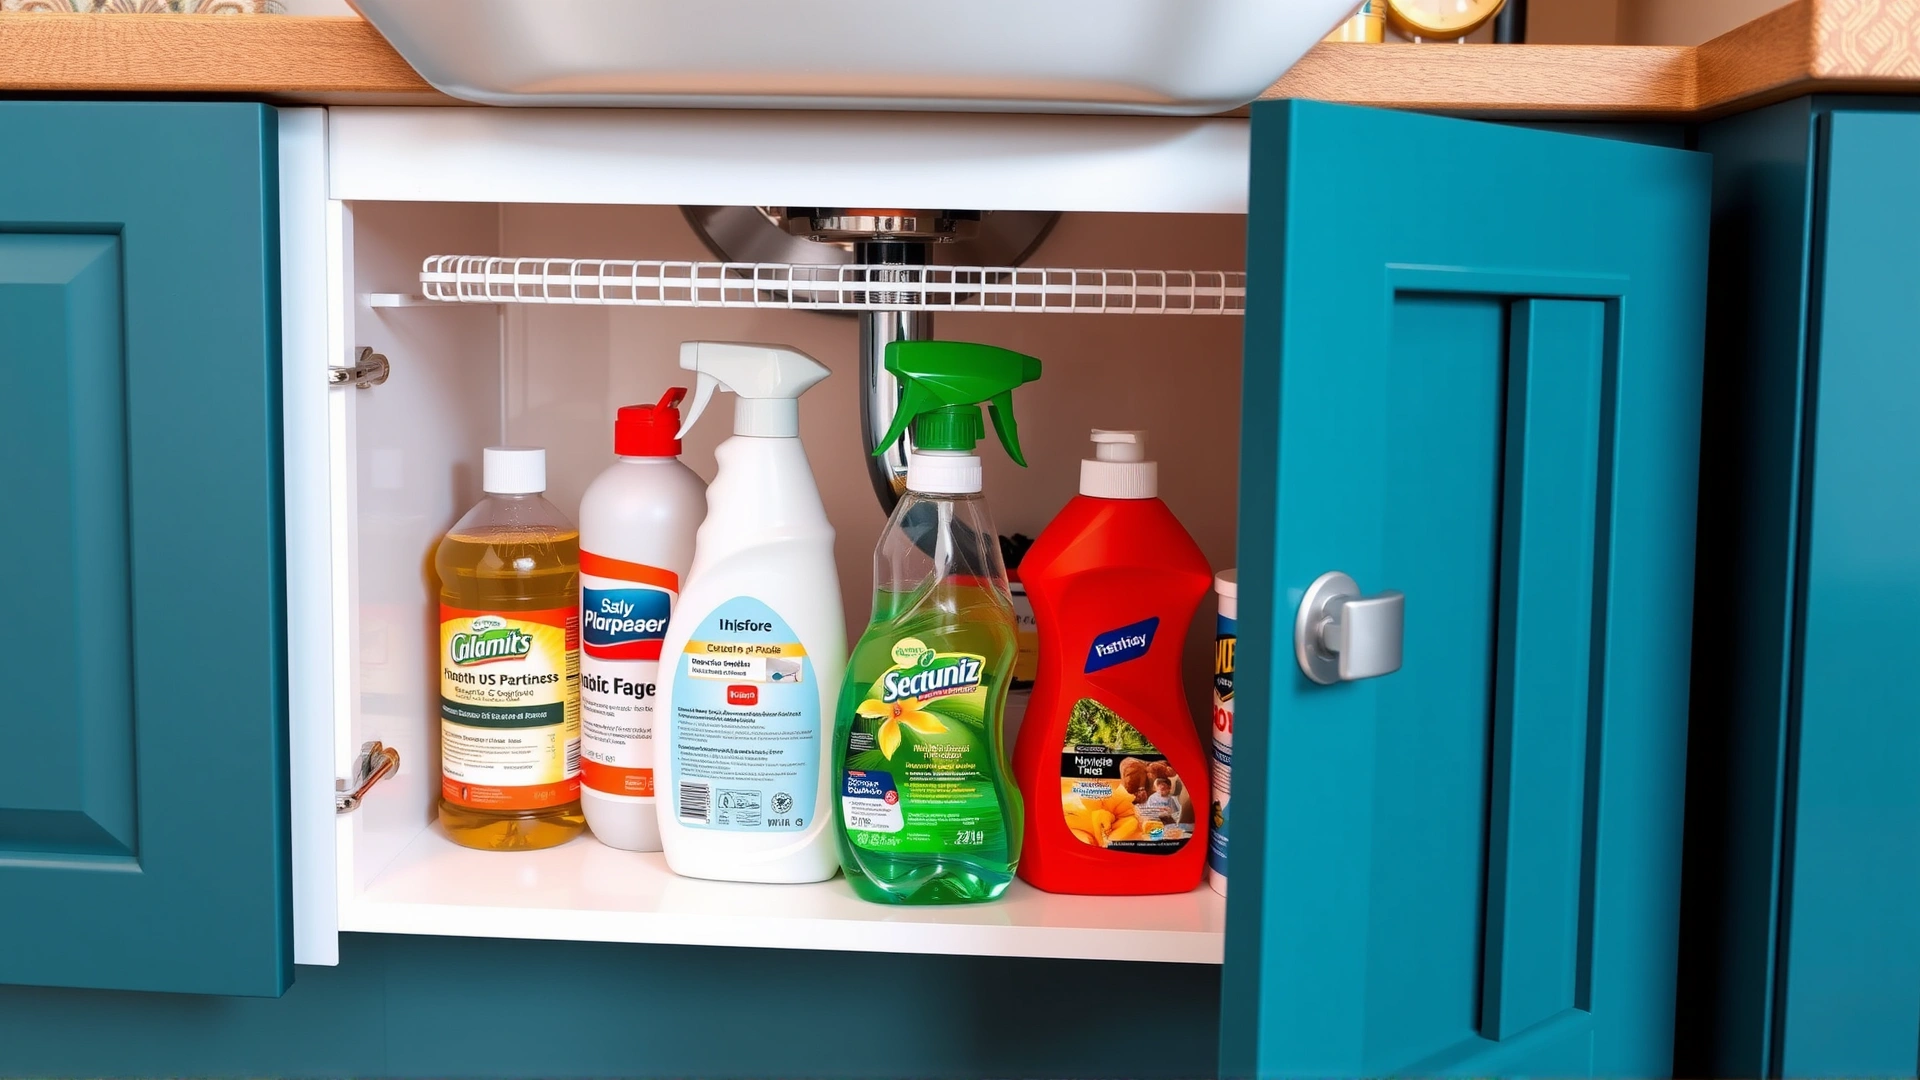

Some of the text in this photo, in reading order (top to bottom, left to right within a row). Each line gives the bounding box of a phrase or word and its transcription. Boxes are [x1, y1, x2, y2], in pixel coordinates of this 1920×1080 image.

[601, 598, 635, 618] Saly
[479, 674, 496, 686] US
[499, 673, 559, 686] Partiness
[613, 677, 656, 700] Fage
